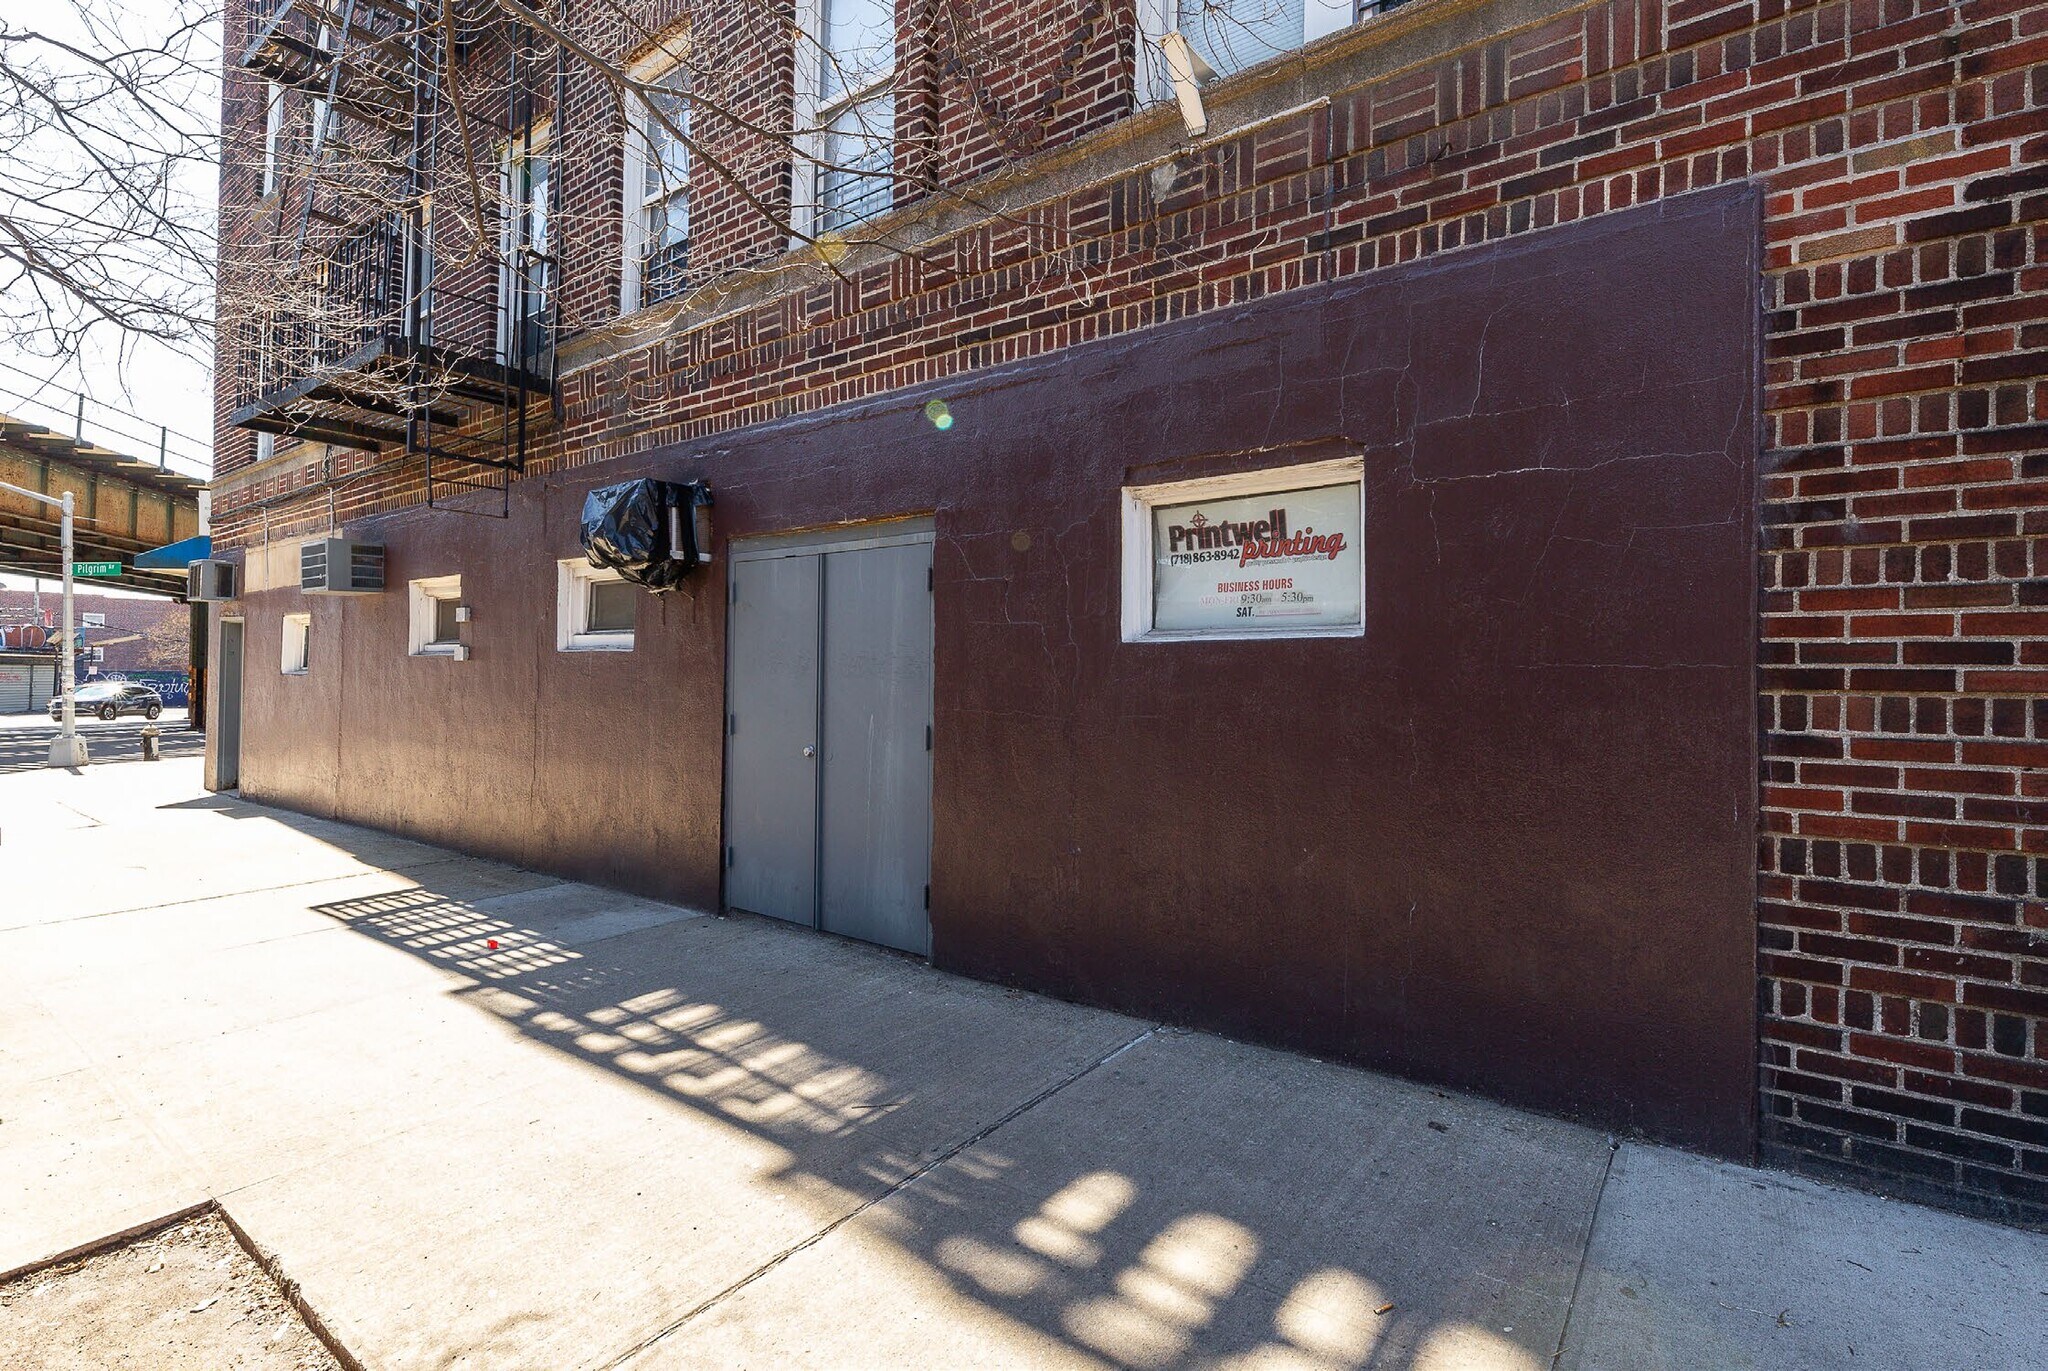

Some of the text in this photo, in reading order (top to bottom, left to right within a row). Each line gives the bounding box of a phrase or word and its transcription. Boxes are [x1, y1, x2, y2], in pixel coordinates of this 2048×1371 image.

[1169, 509, 1288, 552] Printwell
[1239, 526, 1347, 568] printing
[77, 564, 107, 576] Pilgrim
[1217, 577, 1293, 593] BUSINESS HOURS
[1281, 591, 1314, 603] 5:30pm
[1236, 606, 1255, 618] SAT.
